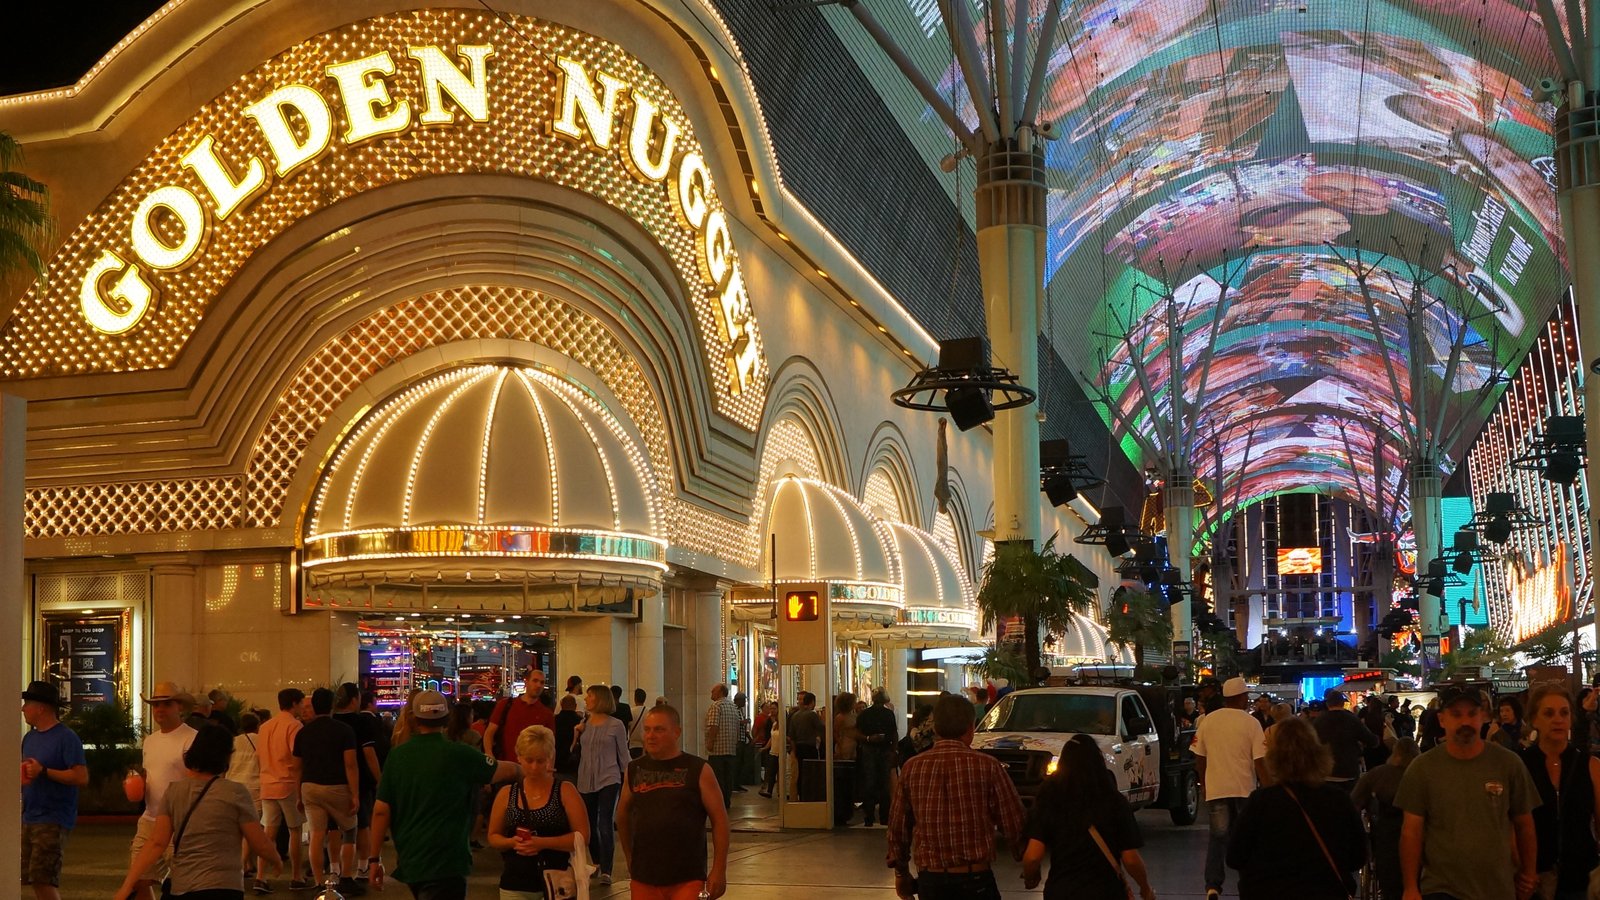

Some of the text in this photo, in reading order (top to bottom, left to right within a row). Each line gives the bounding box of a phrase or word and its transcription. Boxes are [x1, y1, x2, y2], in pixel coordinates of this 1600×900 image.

[80, 44, 763, 396] GOLDEN NUGGET
[1499, 226, 1533, 287] TAG US NOW!
